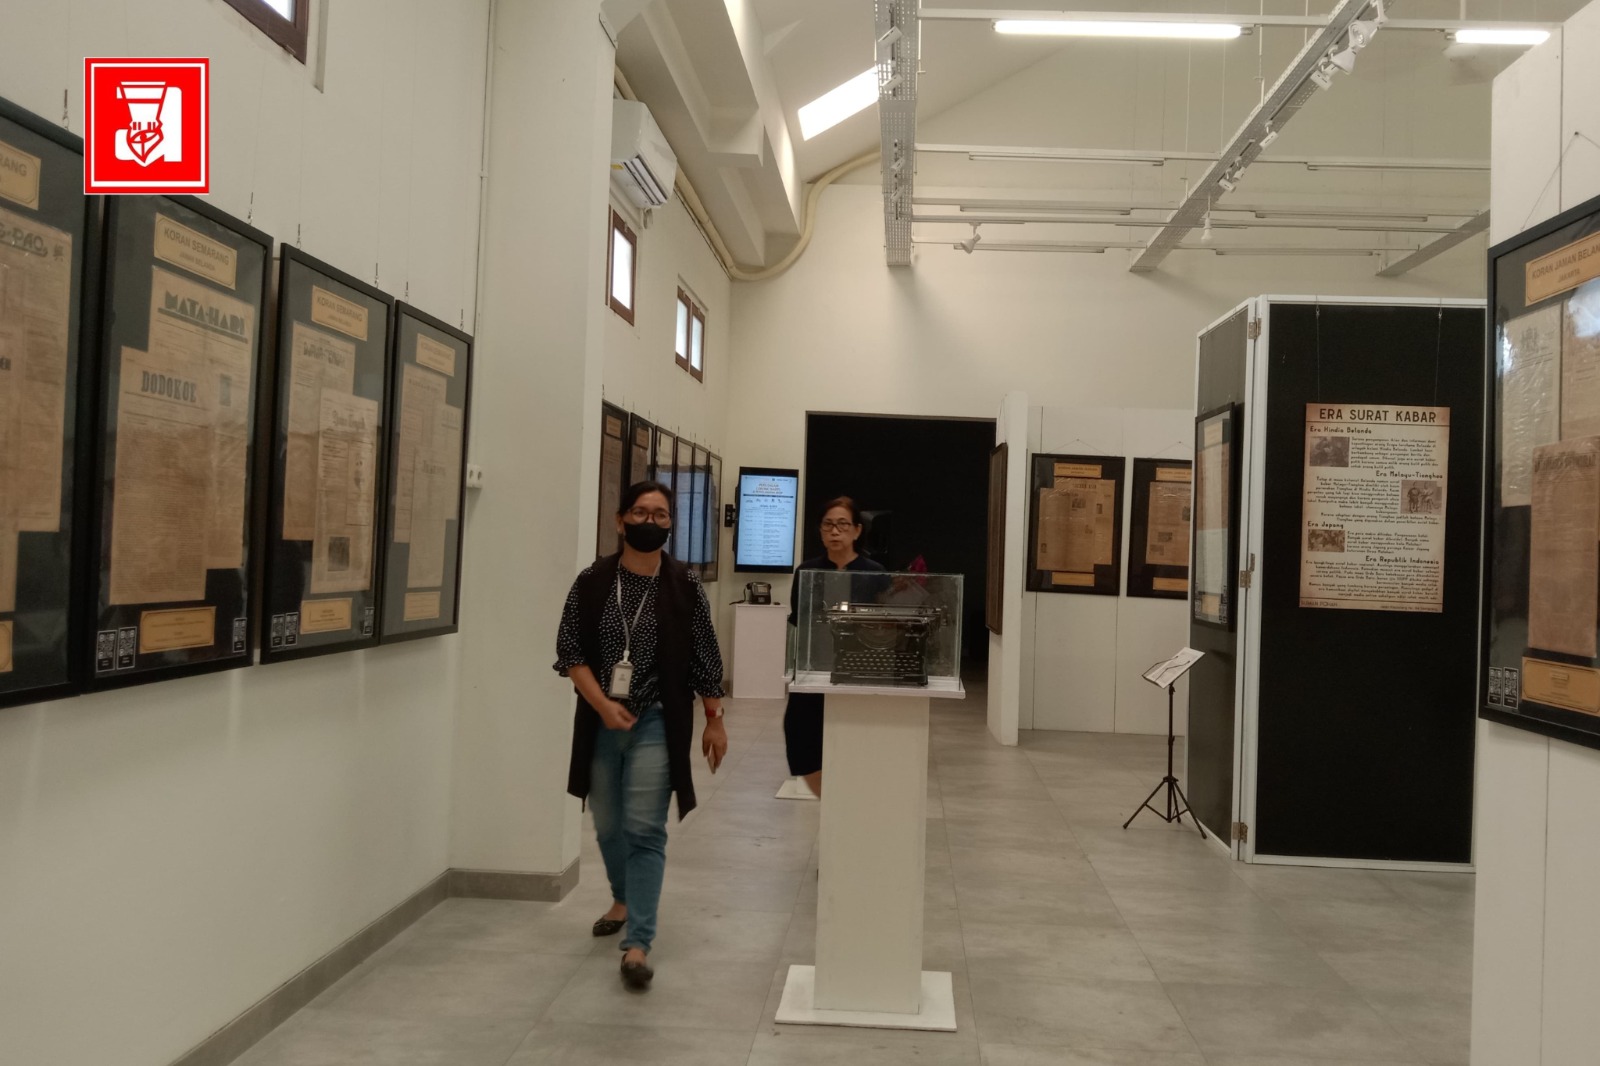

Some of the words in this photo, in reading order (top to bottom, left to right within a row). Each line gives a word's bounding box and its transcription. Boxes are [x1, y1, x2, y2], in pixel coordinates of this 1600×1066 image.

[163, 226, 190, 247] KORAN
[191, 239, 229, 266] SEMARANG
[1532, 265, 1553, 280] KORAN
[1554, 255, 1577, 271] JAMAN
[1558, 268, 1580, 283] JAKARTA
[316, 296, 335, 311] KORAN
[336, 304, 363, 322] SEMARANG
[1319, 408, 1343, 420] ERA
[1349, 409, 1390, 422] SURAT
[1395, 410, 1437, 423] KABAR
[1310, 425, 1322, 433] Era
[1324, 426, 1344, 434] Hindia
[1347, 426, 1372, 435] Belanda
[1376, 469, 1387, 477] Era
[1390, 470, 1443, 480] Melayu-Tionghoa
[1307, 520, 1319, 528] Era
[1322, 521, 1344, 530] Jepang
[1380, 555, 1407, 564] Republik
[1410, 556, 1440, 565] Indonesia
